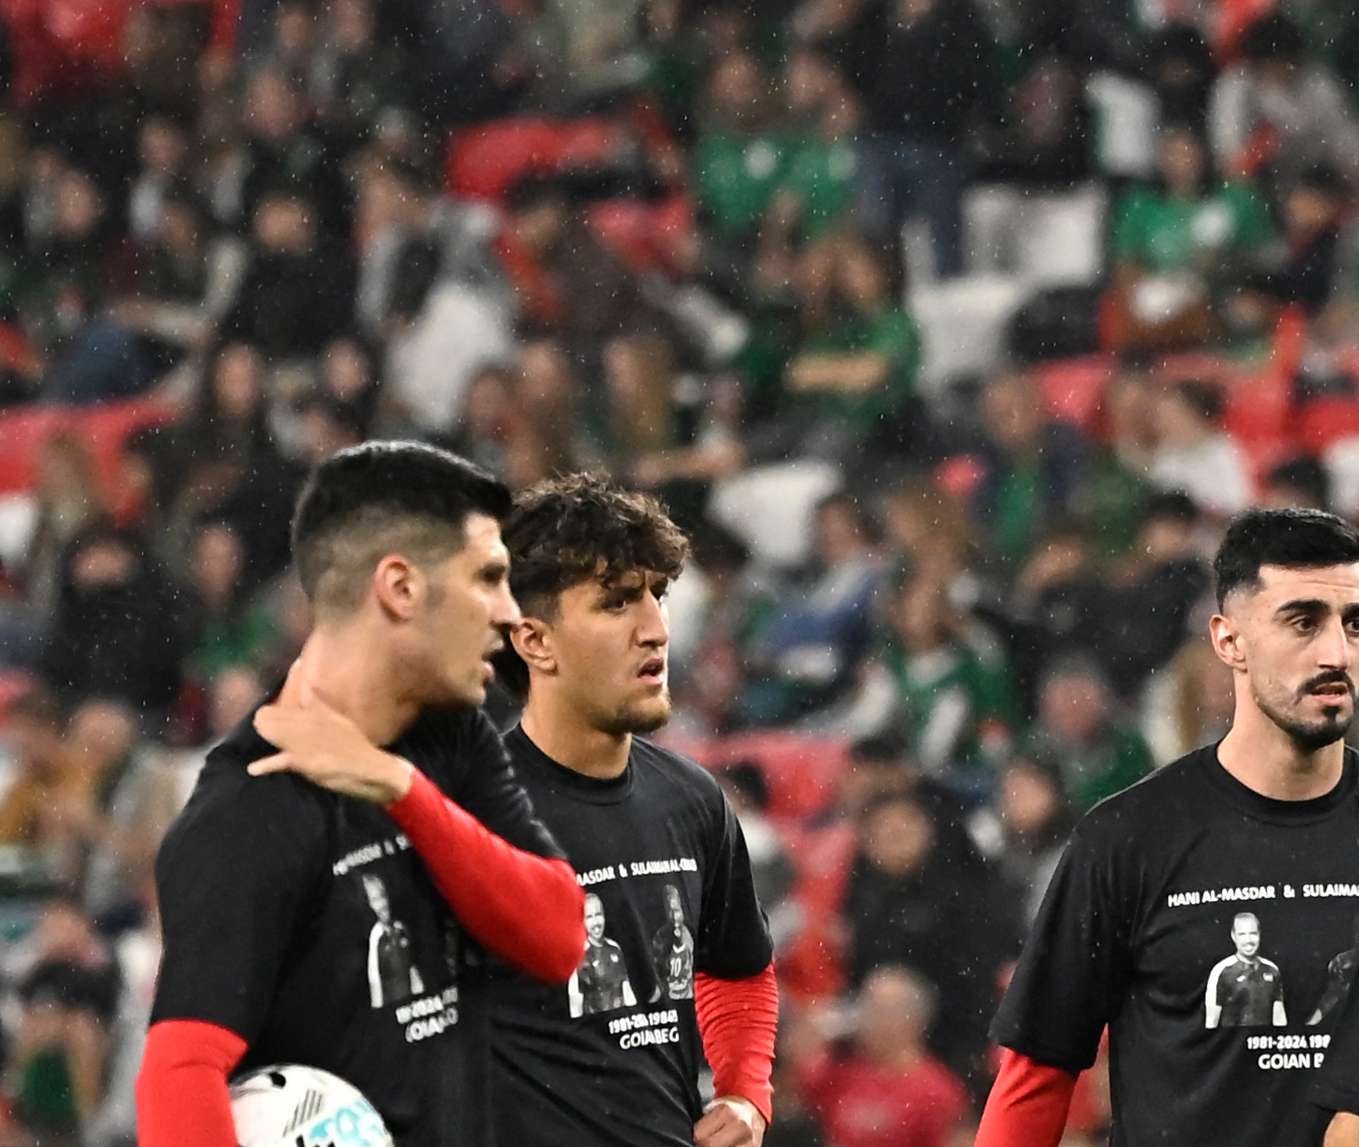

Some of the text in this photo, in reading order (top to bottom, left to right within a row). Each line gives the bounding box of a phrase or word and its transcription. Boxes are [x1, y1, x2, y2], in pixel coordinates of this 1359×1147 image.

[1168, 891, 1200, 908] HANI
[1202, 885, 1276, 903] AL-MASDAR
[1283, 884, 1295, 898] &
[1247, 1034, 1308, 1050] 1981-2024
[1258, 1052, 1310, 1070] GOIAN
